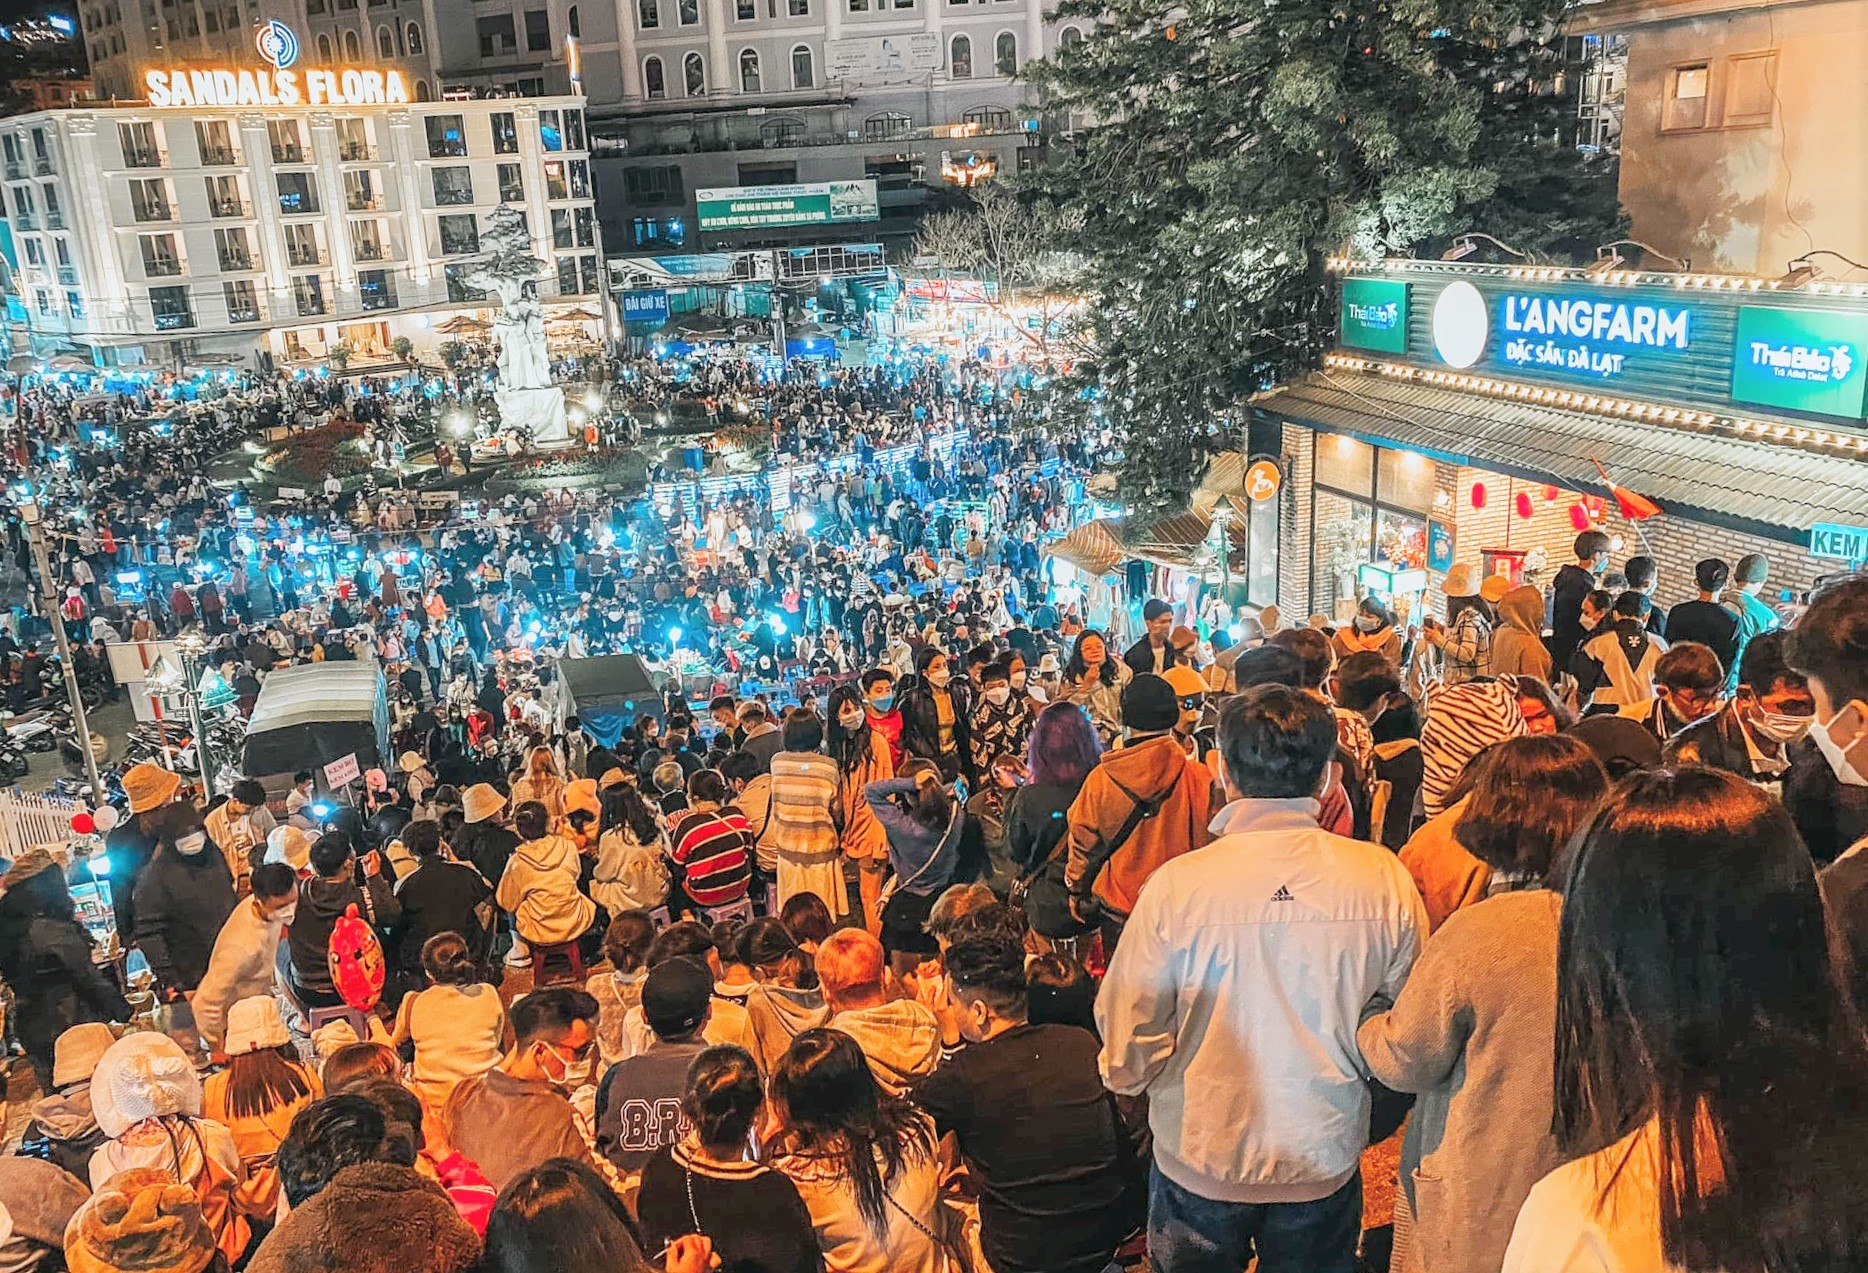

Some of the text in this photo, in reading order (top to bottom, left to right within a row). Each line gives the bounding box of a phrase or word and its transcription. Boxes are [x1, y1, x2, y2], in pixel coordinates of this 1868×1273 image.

[146, 69, 408, 106] SANDALS FLORA
[625, 294, 666, 311] BÃI GIỮ XE
[1506, 296, 1691, 349] L'ANGFARM
[1506, 338, 1534, 366] ĐẶC
[1567, 345, 1590, 370] ĐÀ
[1592, 352, 1625, 377] LẠT
[1813, 531, 1861, 558] KEM
